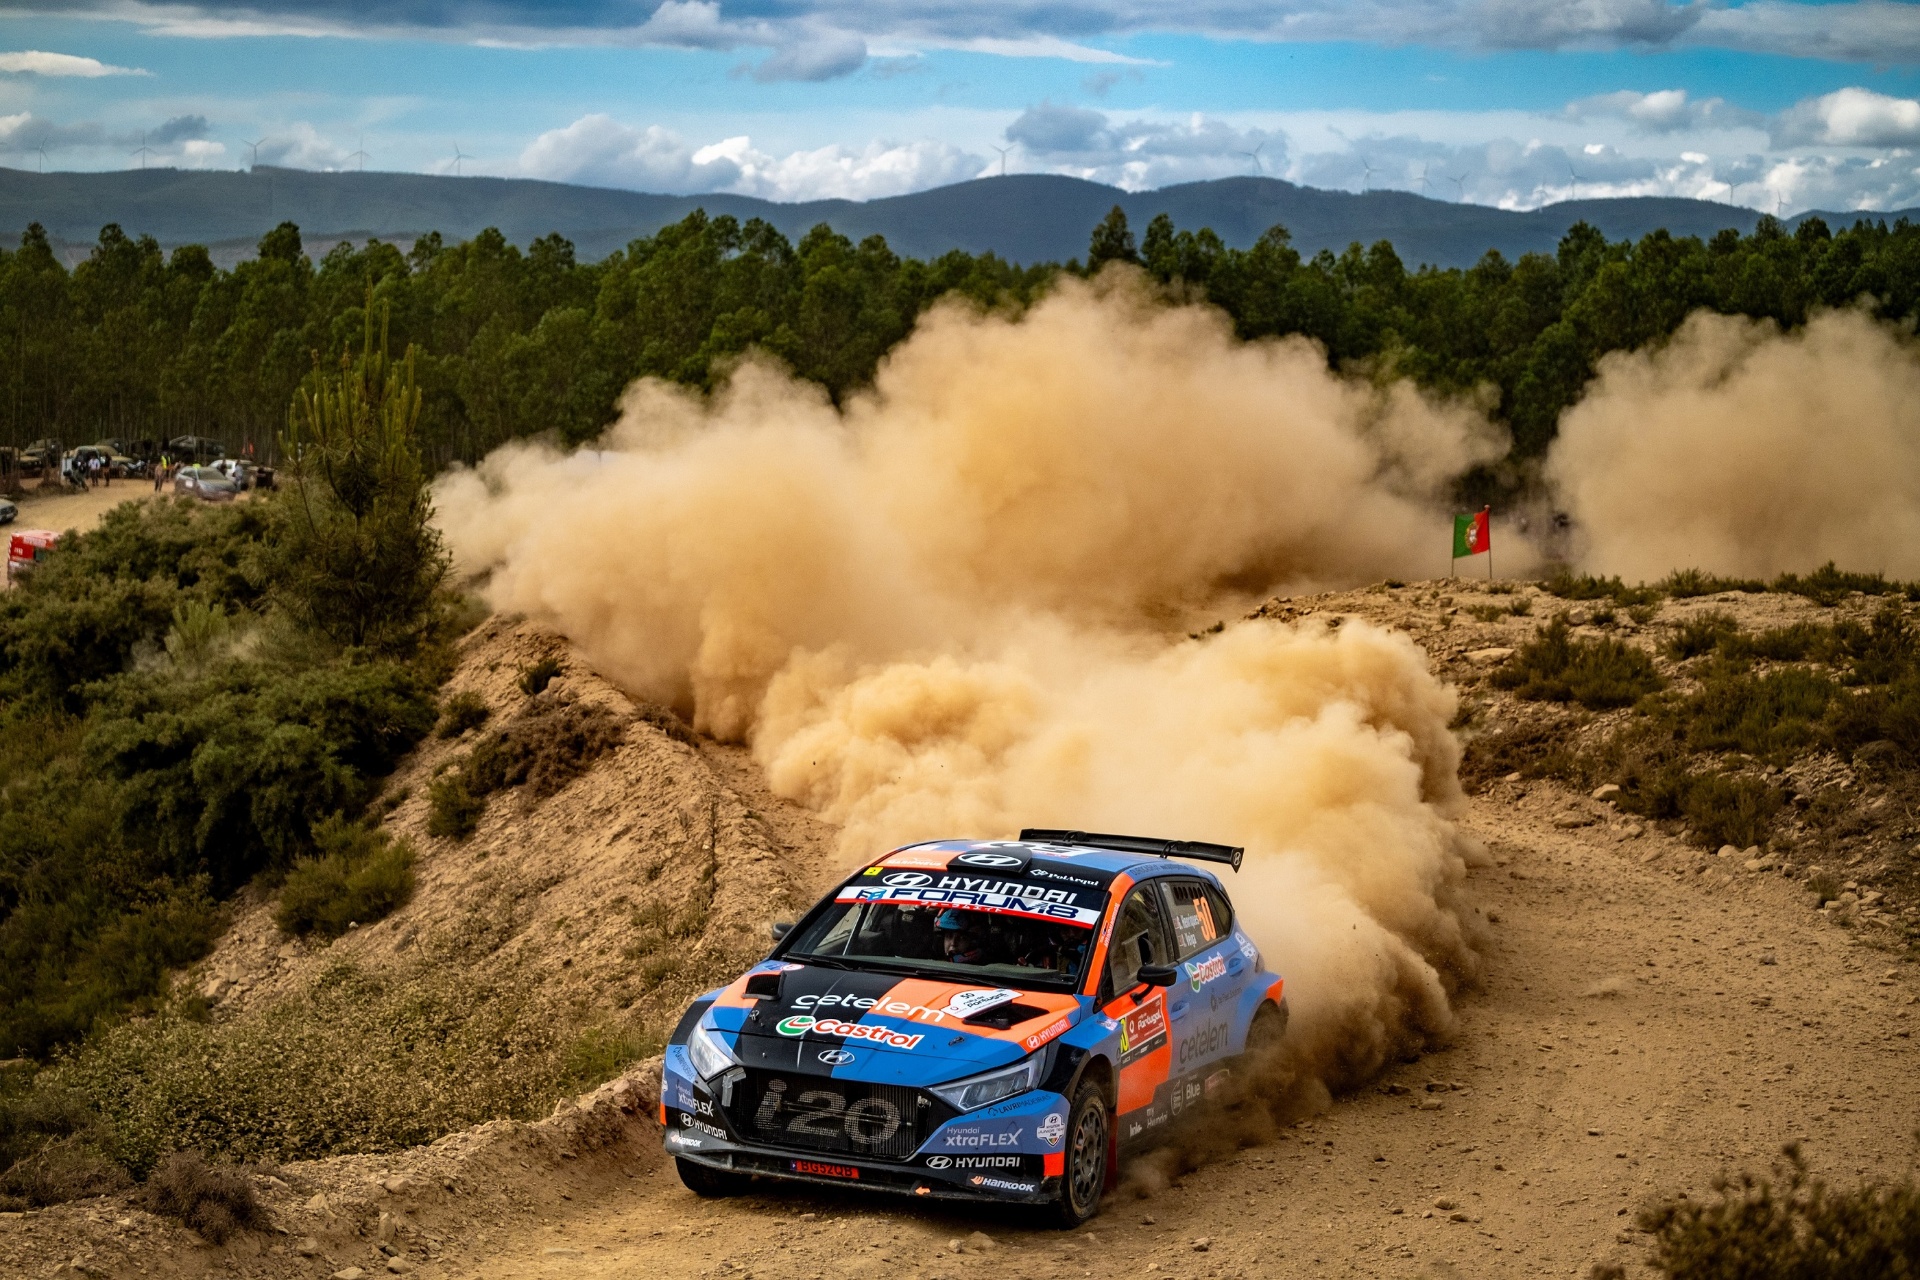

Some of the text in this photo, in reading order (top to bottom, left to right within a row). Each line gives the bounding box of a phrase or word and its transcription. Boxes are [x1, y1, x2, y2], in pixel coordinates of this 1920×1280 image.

[890, 888, 1079, 919] FORUM8
[937, 876, 1077, 904] HYUNDAI
[1193, 896, 1217, 941] 50
[1197, 952, 1226, 984] Castrol
[791, 993, 945, 1022] cetelem
[1138, 1009, 1162, 1030] Portugal
[814, 1018, 924, 1050] Castrol
[1038, 1018, 1067, 1041] HYUNDAI
[1180, 1018, 1228, 1064] cetelem
[1186, 1083, 1200, 1100] Blue
[753, 1079, 900, 1145] i20
[694, 1118, 727, 1140] HYUNDAI
[945, 1128, 1023, 1146] xtraFLEX
[946, 1127, 980, 1135] Hyundai
[955, 1157, 1020, 1168] HYUNDAI
